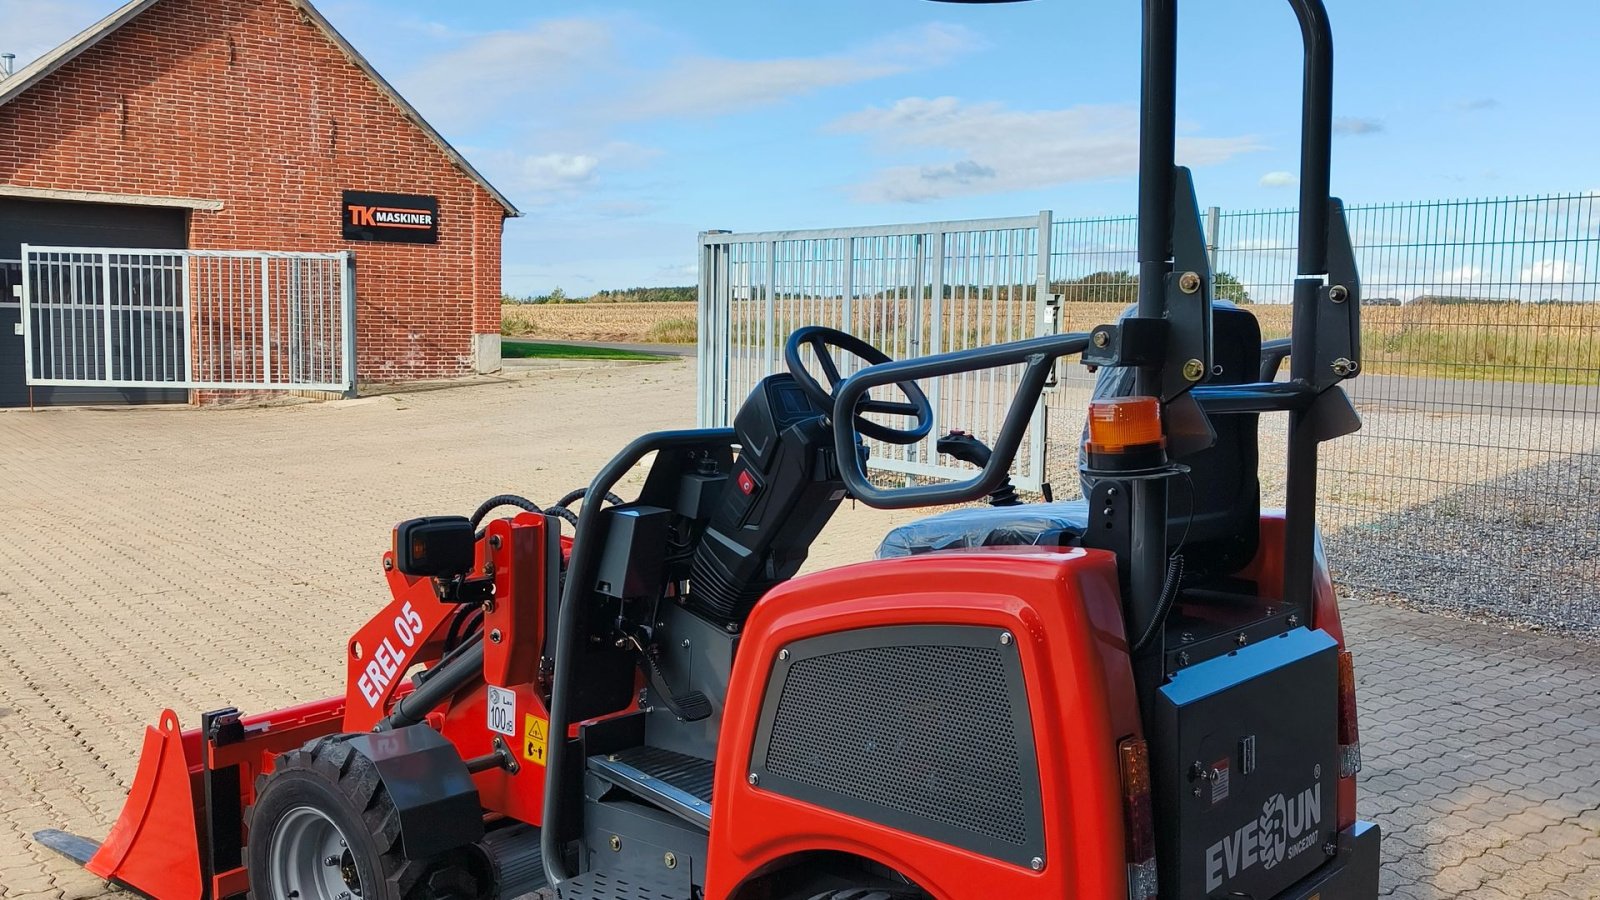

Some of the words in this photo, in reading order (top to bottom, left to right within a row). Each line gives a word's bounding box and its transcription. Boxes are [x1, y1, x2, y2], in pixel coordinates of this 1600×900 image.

[348, 205, 377, 226] TK
[376, 212, 432, 224] MASKINER
[357, 637, 406, 708] EREL
[394, 600, 423, 647] 05
[491, 706, 506, 730] 100
